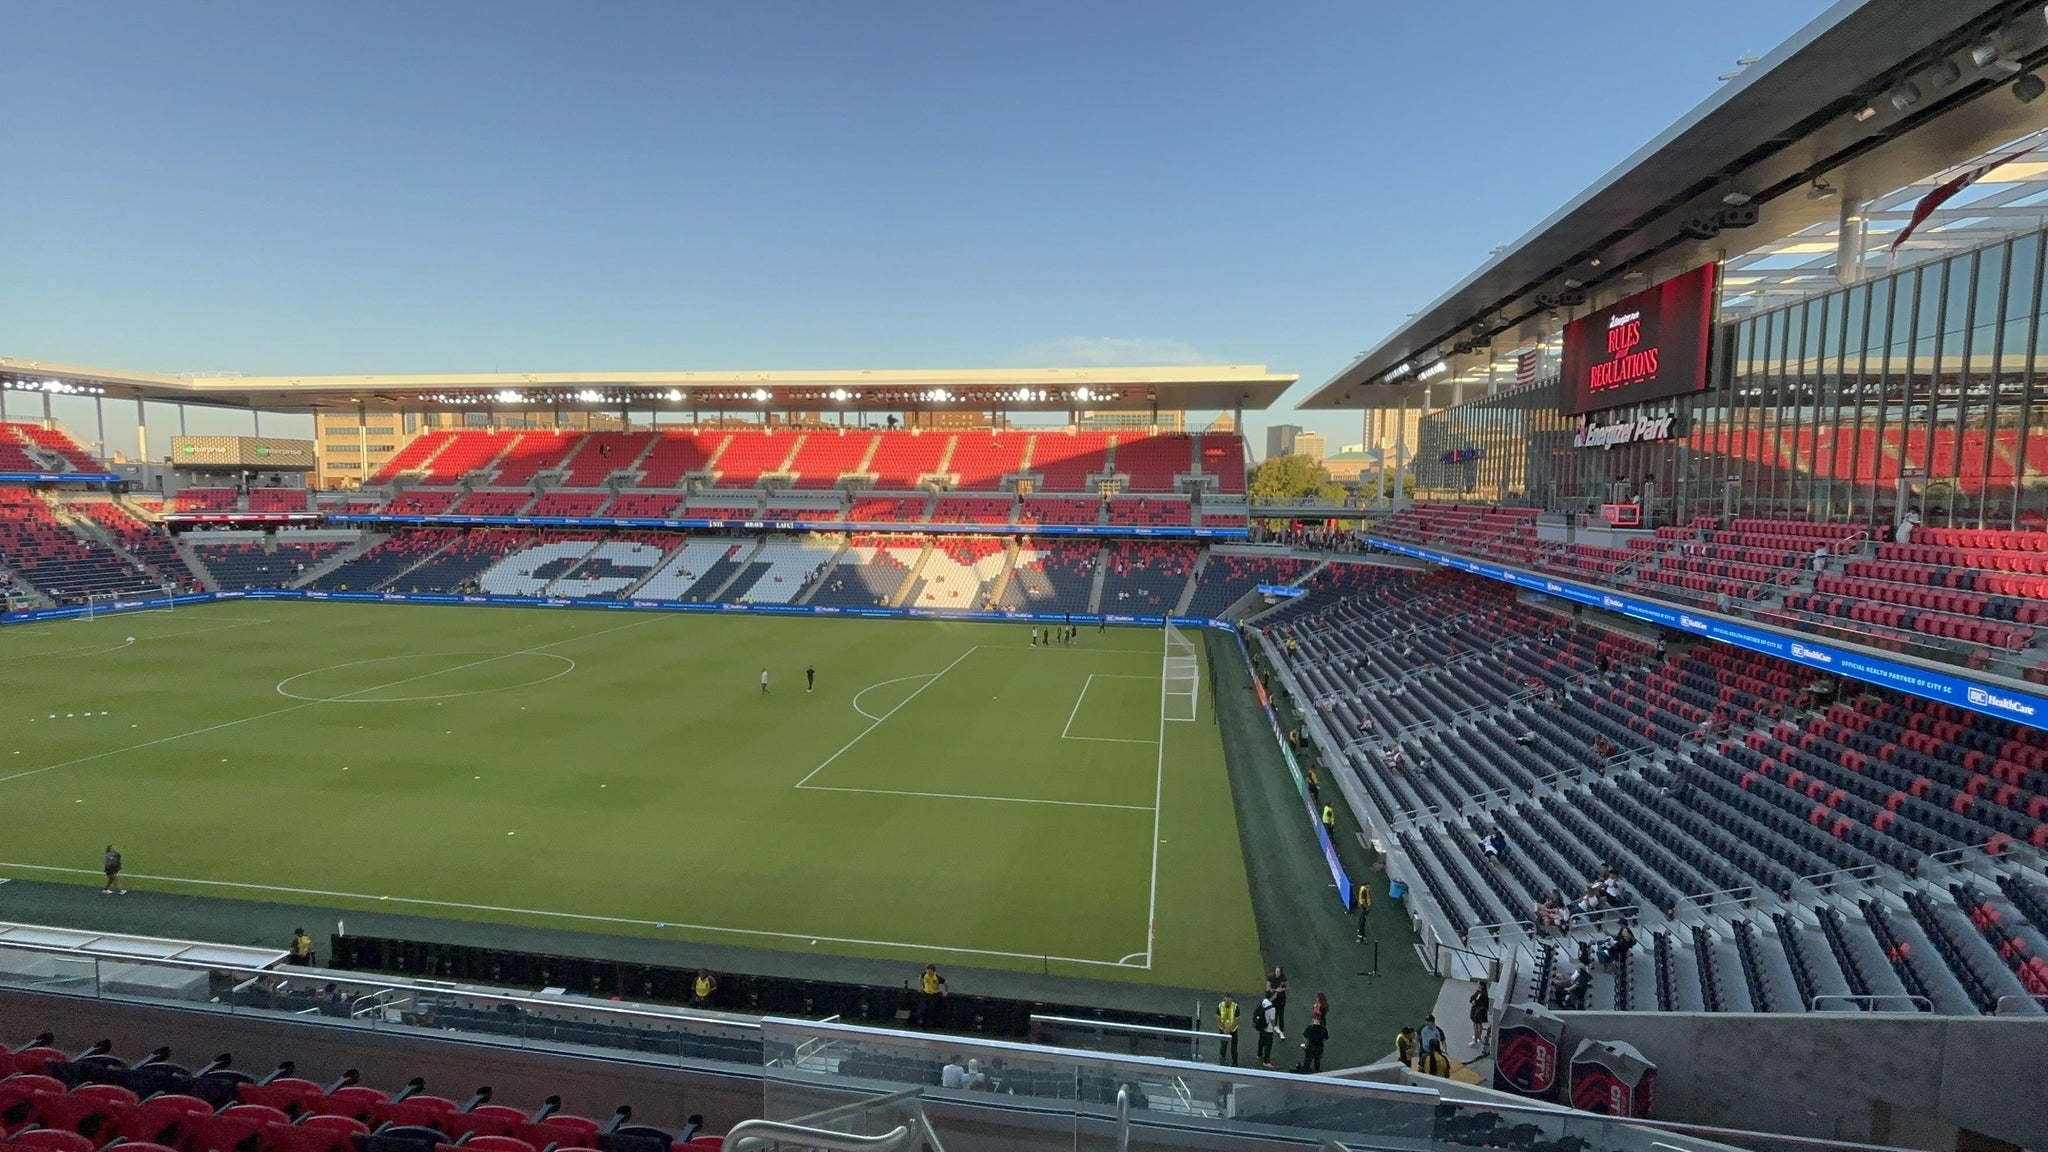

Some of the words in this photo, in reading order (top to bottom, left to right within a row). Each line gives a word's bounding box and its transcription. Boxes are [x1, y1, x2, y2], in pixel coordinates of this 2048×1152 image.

[1608, 321, 1640, 352] RULES
[1590, 348, 1658, 388] REGULATIONS
[1585, 420, 1635, 450] Energizer
[1634, 412, 1672, 441] Park
[1804, 649, 1832, 663] HealthCare
[1841, 660, 1864, 671] OFFICIAL
[1866, 667, 1887, 677] HEALTH
[1888, 672, 1915, 684] PARTNER
[1916, 678, 1925, 687] OF
[1926, 681, 1941, 691] CITY
[1943, 685, 1952, 693] SC
[1988, 696, 2034, 715] HealthCare
[1535, 1046, 1546, 1081] CITY
